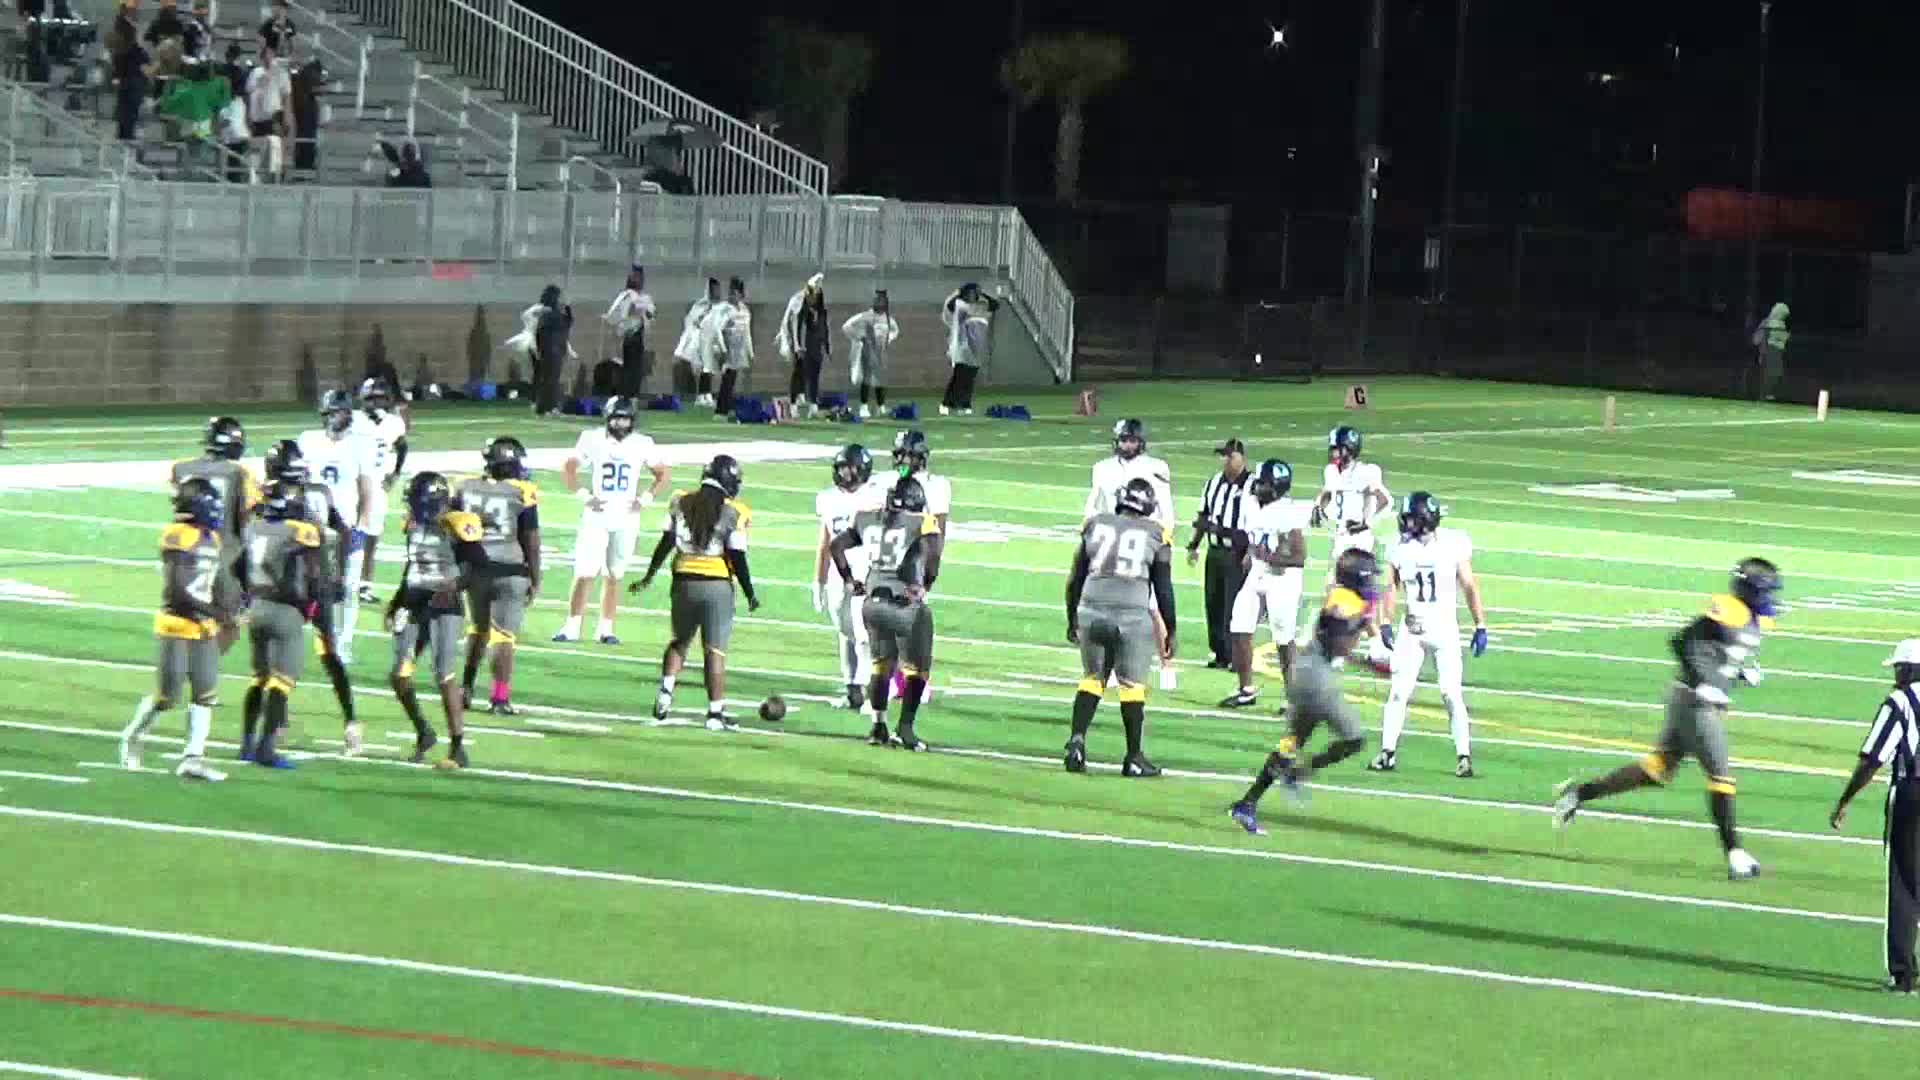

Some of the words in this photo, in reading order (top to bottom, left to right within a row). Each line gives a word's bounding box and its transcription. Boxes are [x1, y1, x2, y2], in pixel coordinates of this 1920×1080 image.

[1354, 387, 1366, 405] G
[601, 463, 631, 491] 26
[1088, 523, 1148, 578] 79
[1415, 571, 1437, 602] 11
